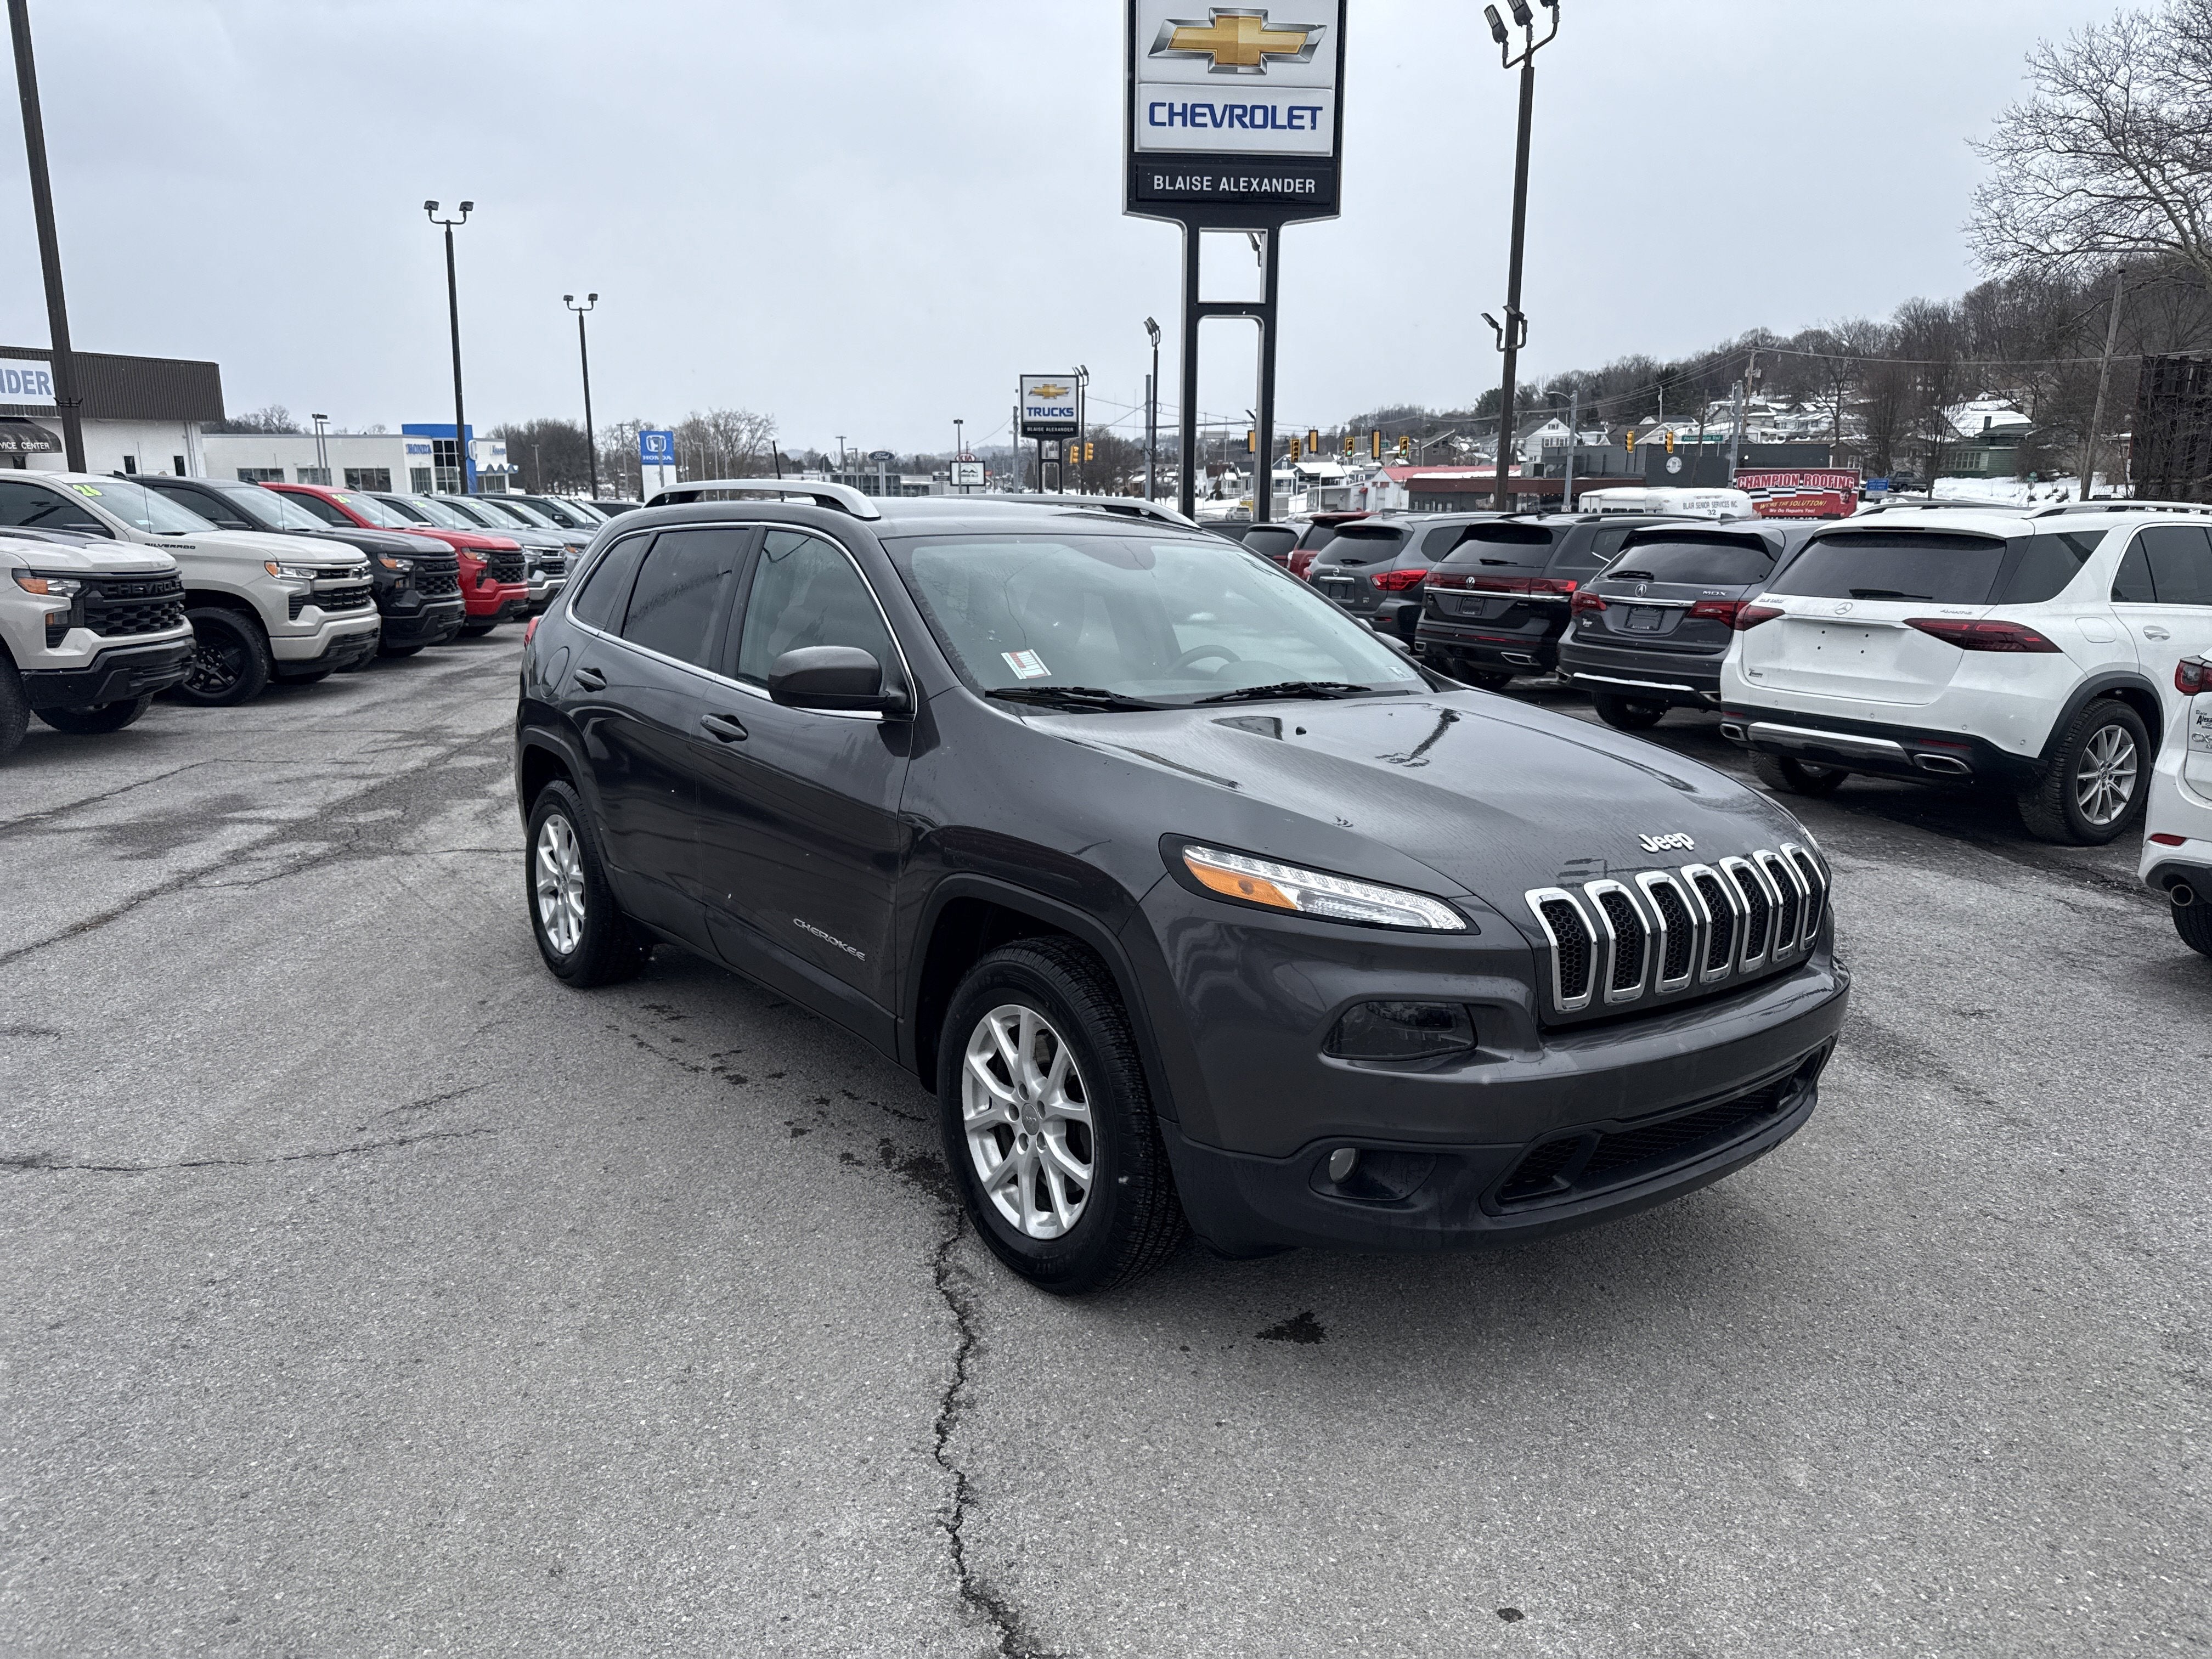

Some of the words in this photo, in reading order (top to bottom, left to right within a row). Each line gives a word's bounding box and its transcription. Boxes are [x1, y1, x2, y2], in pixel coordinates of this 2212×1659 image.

[1149, 101, 1323, 131] CHEVROLET
[1154, 174, 1212, 191] BLAISE
[1219, 176, 1316, 194] ALEXANDER
[1026, 407, 1074, 417] TRUCKS
[21, 442, 50, 450] CENTER
[406, 443, 432, 455] HONDA
[1737, 473, 1800, 489] CHAMPION
[1803, 473, 1855, 489] ROOFING
[1638, 832, 1695, 854] Jeep
[793, 918, 866, 962] CHEROKEE
